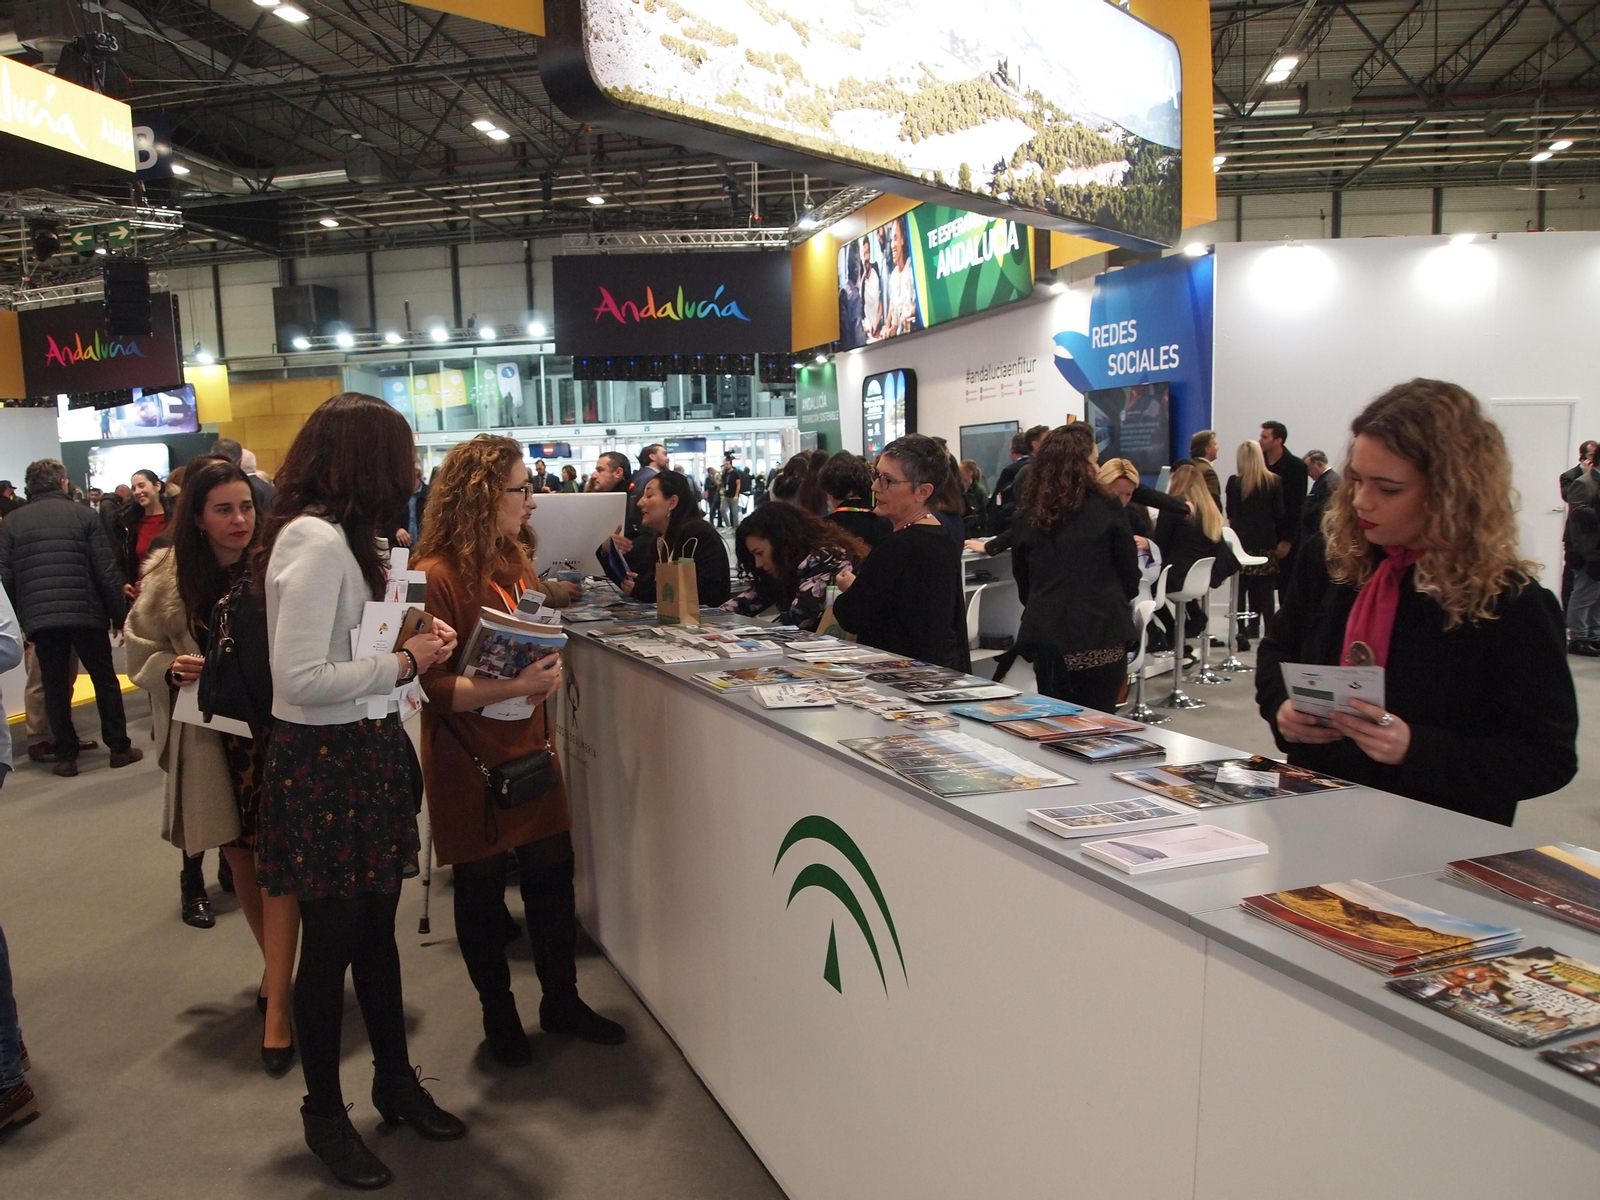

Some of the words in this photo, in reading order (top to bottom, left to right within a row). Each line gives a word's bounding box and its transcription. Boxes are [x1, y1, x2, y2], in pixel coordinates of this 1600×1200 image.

[0, 63, 88, 152] lucía
[927, 227, 938, 249] TE
[936, 219, 1020, 280] ANDALUCÍA
[593, 284, 751, 325] Andalucía
[1092, 319, 1137, 349] REDES
[966, 356, 1037, 385] #andaluciaenfitur
[1107, 344, 1180, 376] SOCIALES
